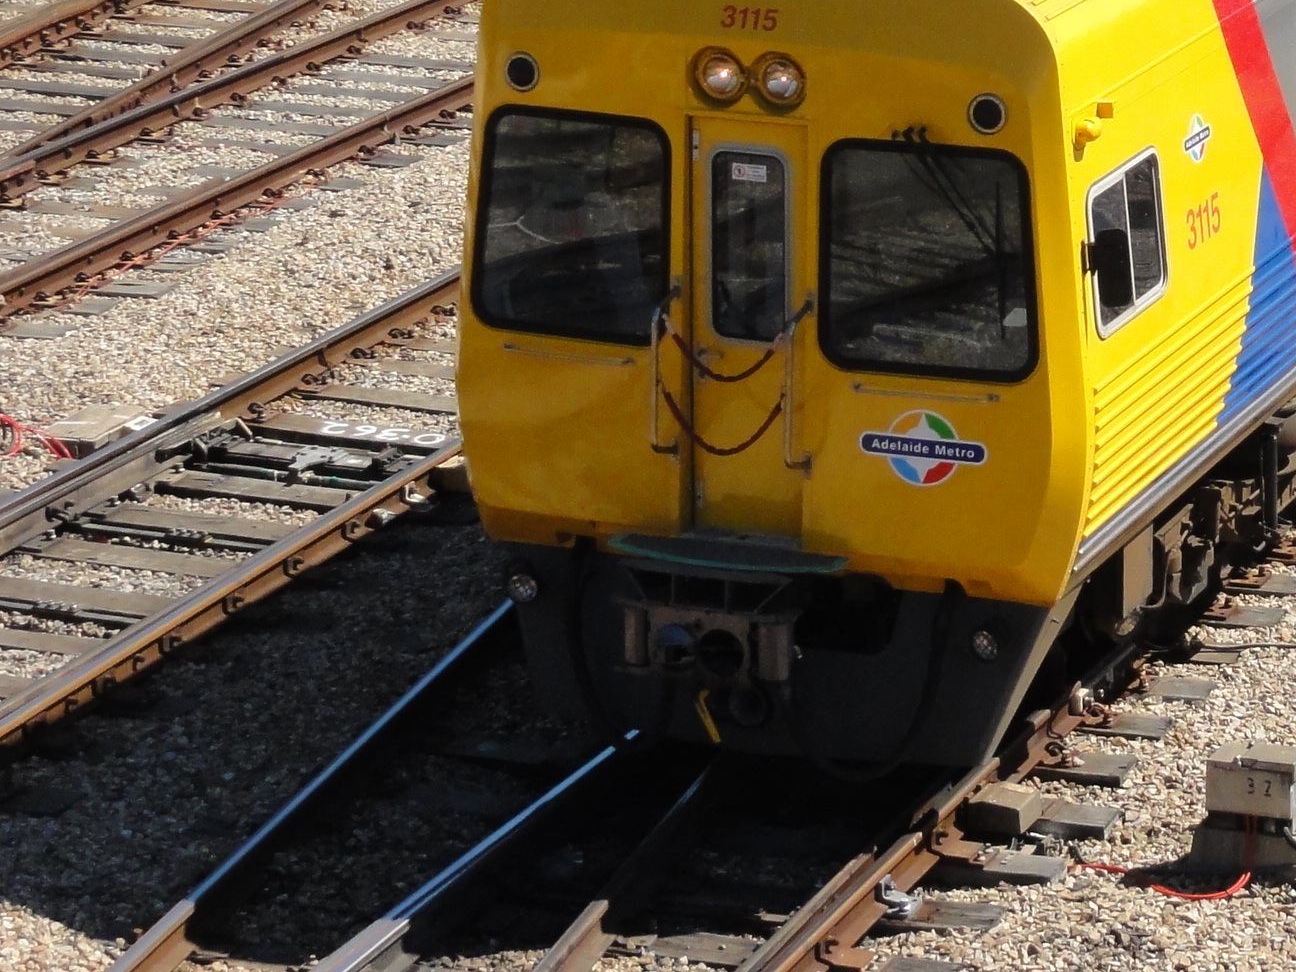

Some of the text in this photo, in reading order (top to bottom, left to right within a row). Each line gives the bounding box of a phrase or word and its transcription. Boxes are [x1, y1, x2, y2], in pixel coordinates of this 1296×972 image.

[720, 4, 779, 31] 3115
[1186, 191, 1221, 250] 3115
[871, 438, 975, 459] Adelaide Metro
